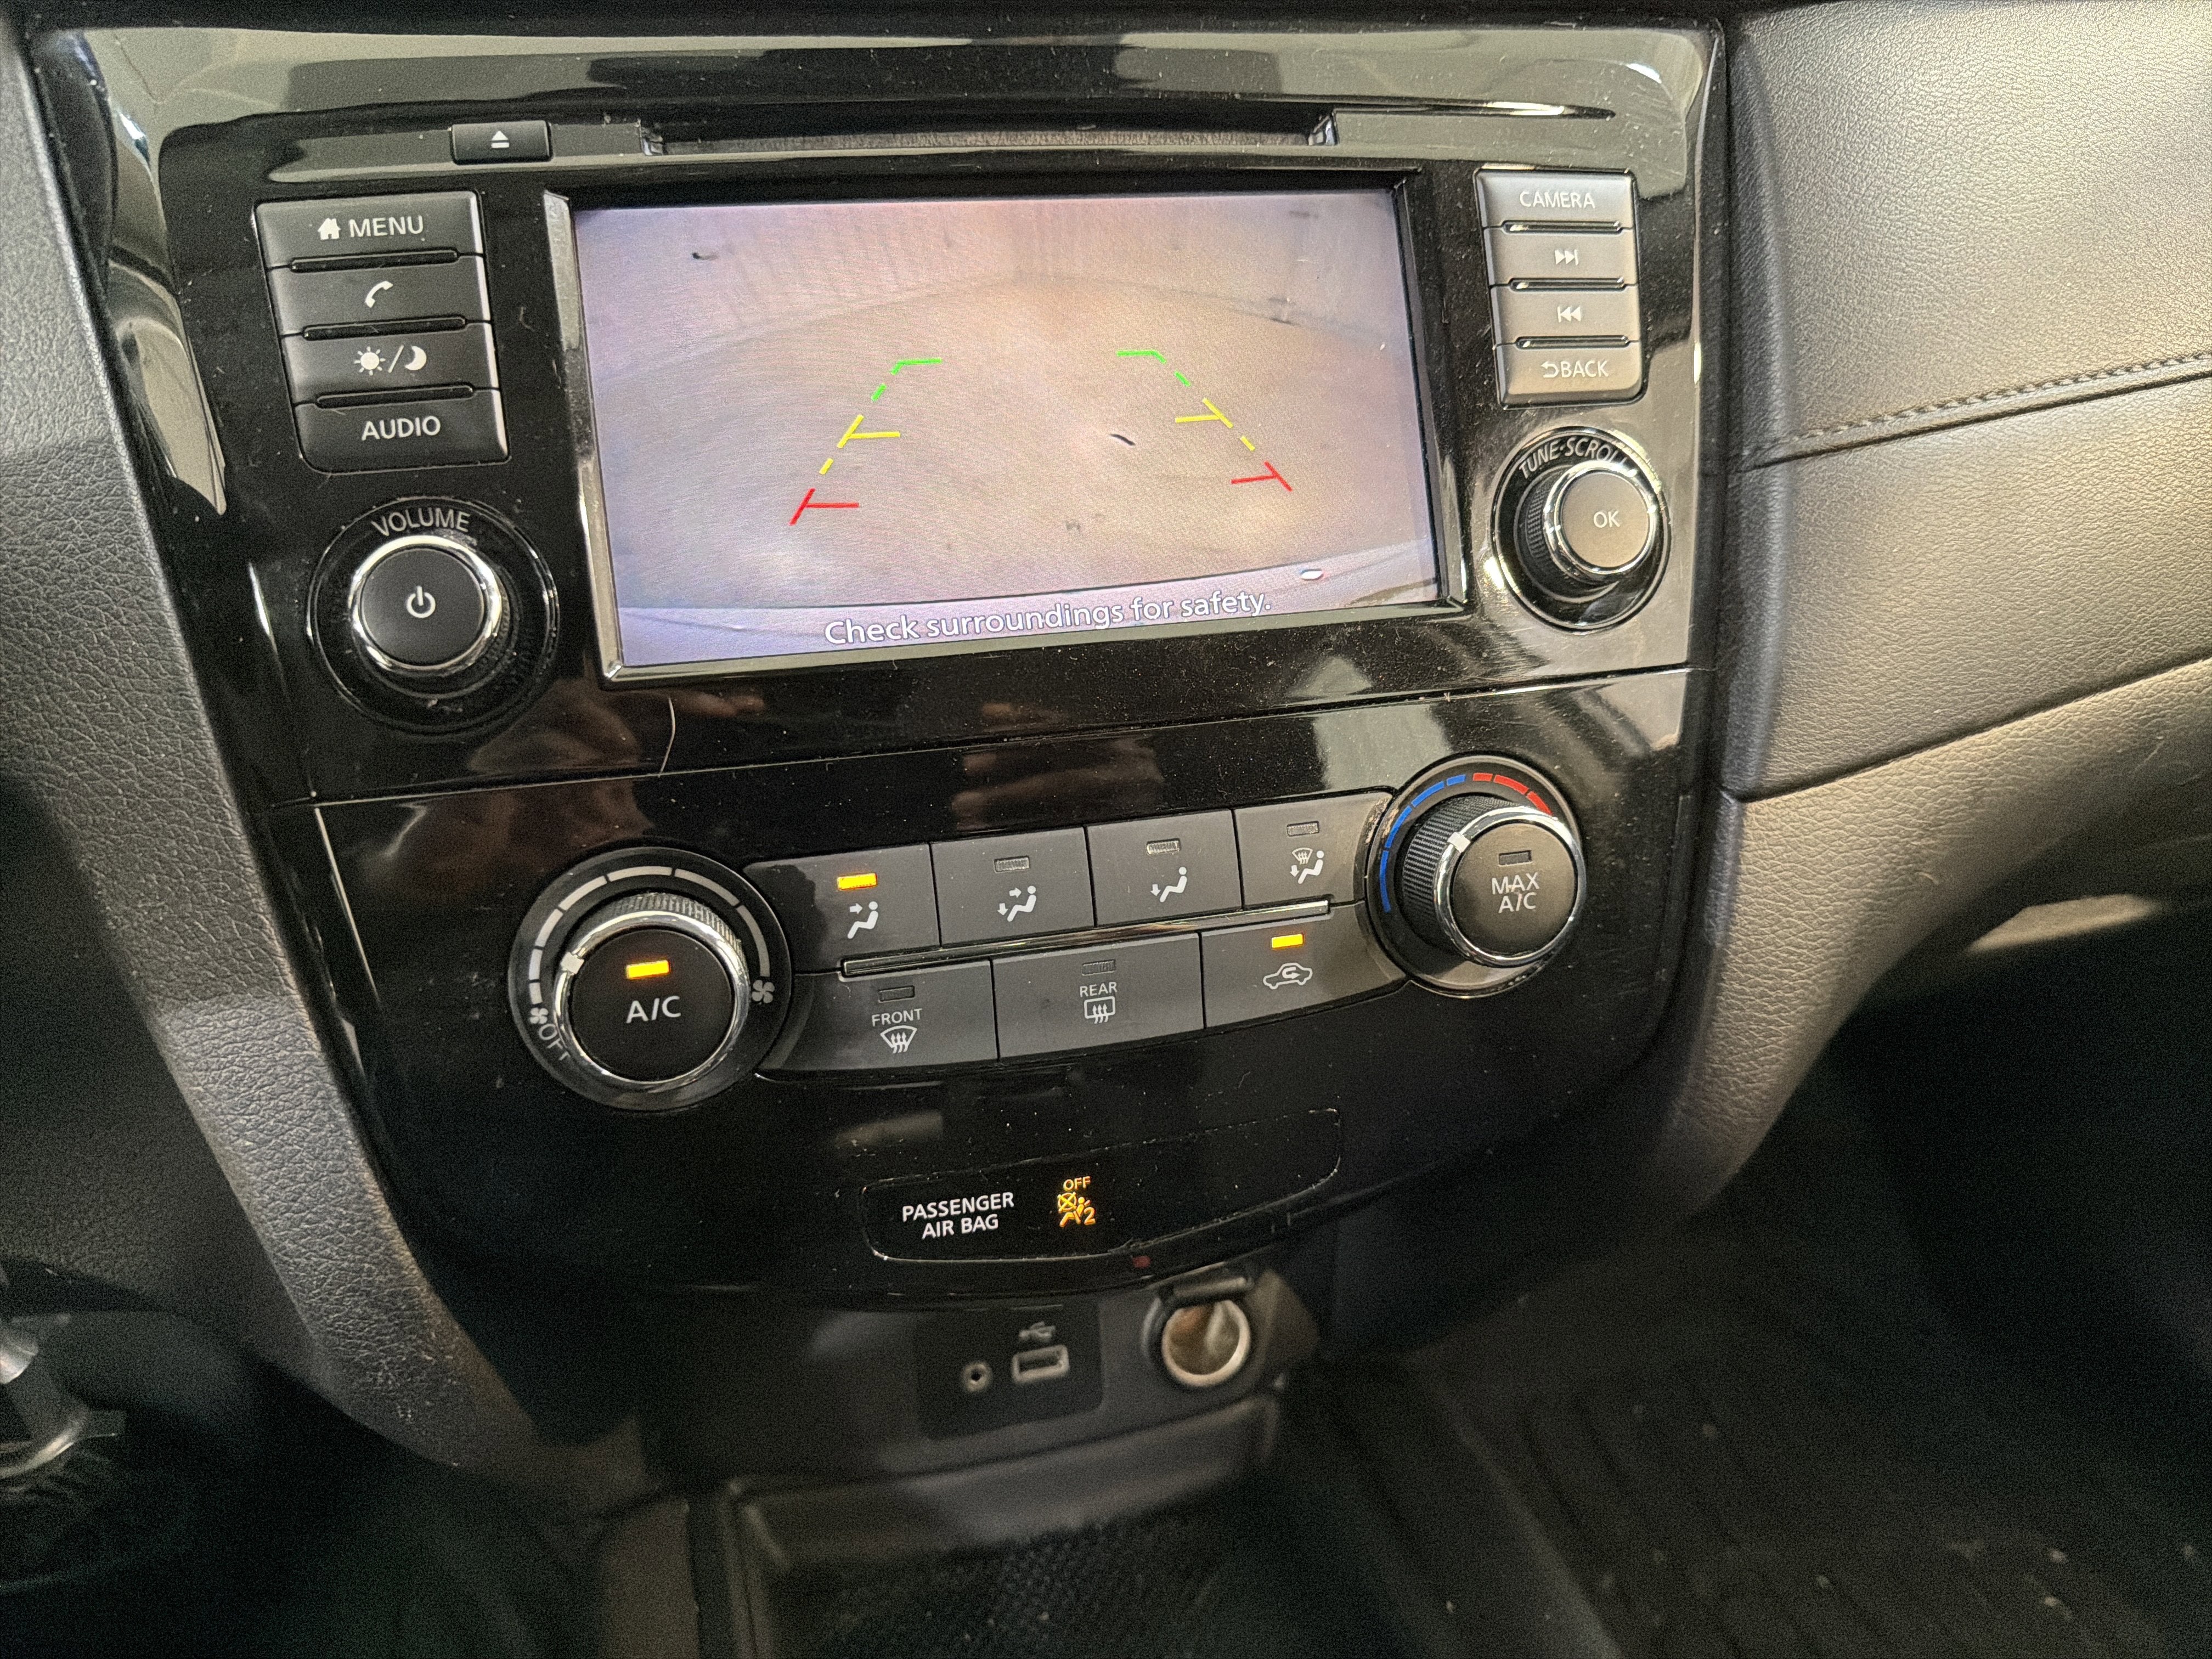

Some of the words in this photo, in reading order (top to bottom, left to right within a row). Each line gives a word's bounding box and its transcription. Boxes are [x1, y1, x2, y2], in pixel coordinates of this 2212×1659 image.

[1519, 191, 1595, 208] CAMERA
[349, 215, 424, 238] MENU
[1561, 360, 1609, 378] BACK
[362, 416, 441, 441] AUDIO
[371, 508, 471, 537] VOLUME
[1593, 511, 1621, 528] OK
[825, 614, 920, 644] Check
[927, 603, 1123, 637] surroundings
[1131, 596, 1173, 620] for
[1181, 590, 1271, 616] safety.
[1491, 872, 1539, 895] MAX
[1498, 892, 1537, 913] A/C
[1079, 981, 1118, 997] REAR
[625, 996, 681, 1024] A/C
[872, 1008, 923, 1026] FRONT
[1063, 1176, 1091, 1191] OFF
[902, 1192, 1014, 1222] PASSENGER
[922, 1219, 955, 1240] AIR
[961, 1214, 999, 1234] BAG
